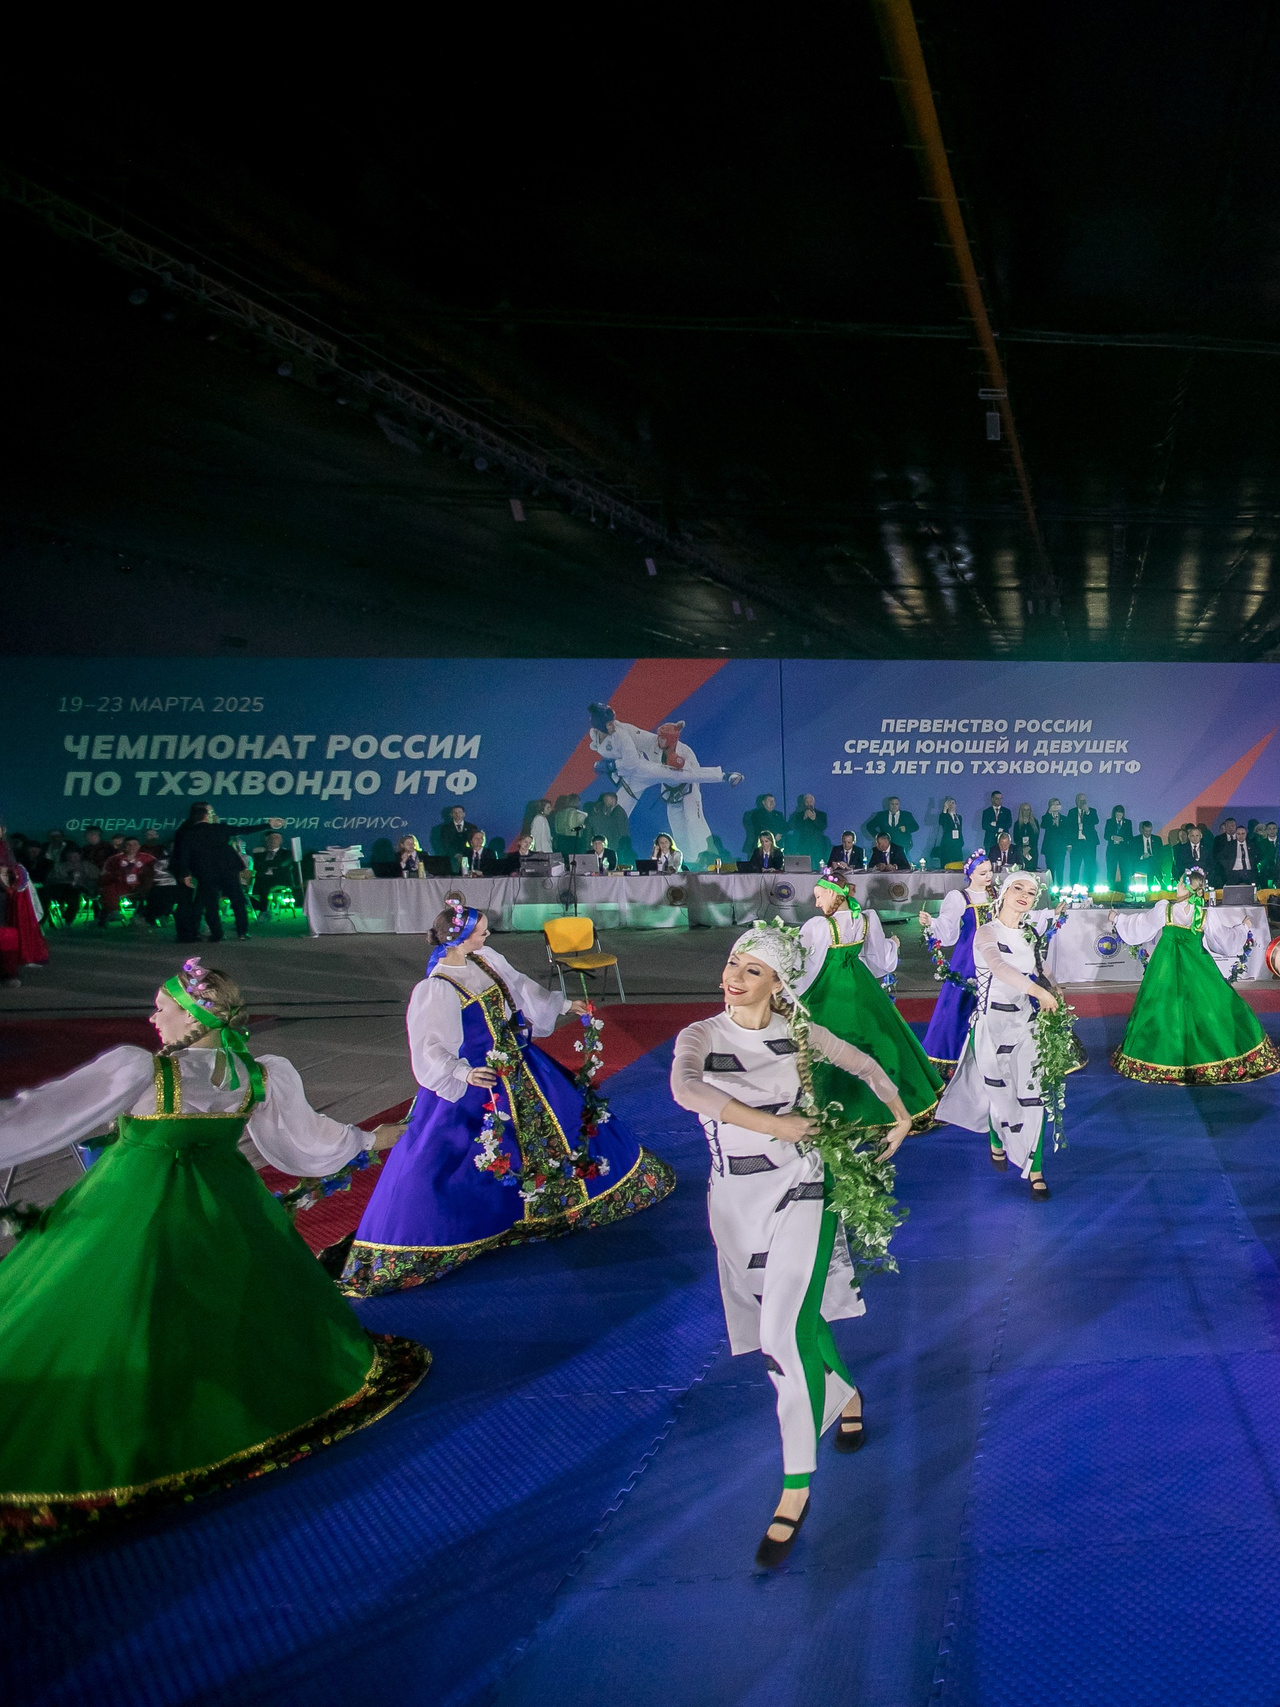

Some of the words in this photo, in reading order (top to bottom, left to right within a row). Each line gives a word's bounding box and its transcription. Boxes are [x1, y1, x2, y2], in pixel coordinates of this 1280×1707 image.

[130, 697, 206, 712] МАРТА
[213, 697, 264, 712] 2025
[881, 719, 1009, 733] ПЕРВЕНСТВО
[1013, 719, 1093, 733] РОССИИ
[63, 734, 317, 760] ЧЕМПИОНАТ
[325, 734, 482, 760] РОССИИ
[844, 740, 910, 757] СРЕДИ
[915, 736, 1010, 754] ЮНОШЕЙ
[1014, 740, 1029, 754] И
[1032, 740, 1130, 757] ДЕВУШЕК
[891, 760, 931, 775] ЛЕТ
[935, 760, 965, 775] ПО
[970, 760, 1094, 777] ТХЭКВОНДО
[1098, 759, 1142, 774] ИТФ
[63, 771, 123, 797] ПО
[134, 770, 382, 801] ТХЭКВОНДО
[393, 768, 478, 796] ИТФ
[323, 816, 409, 830] «СИРИУС»
